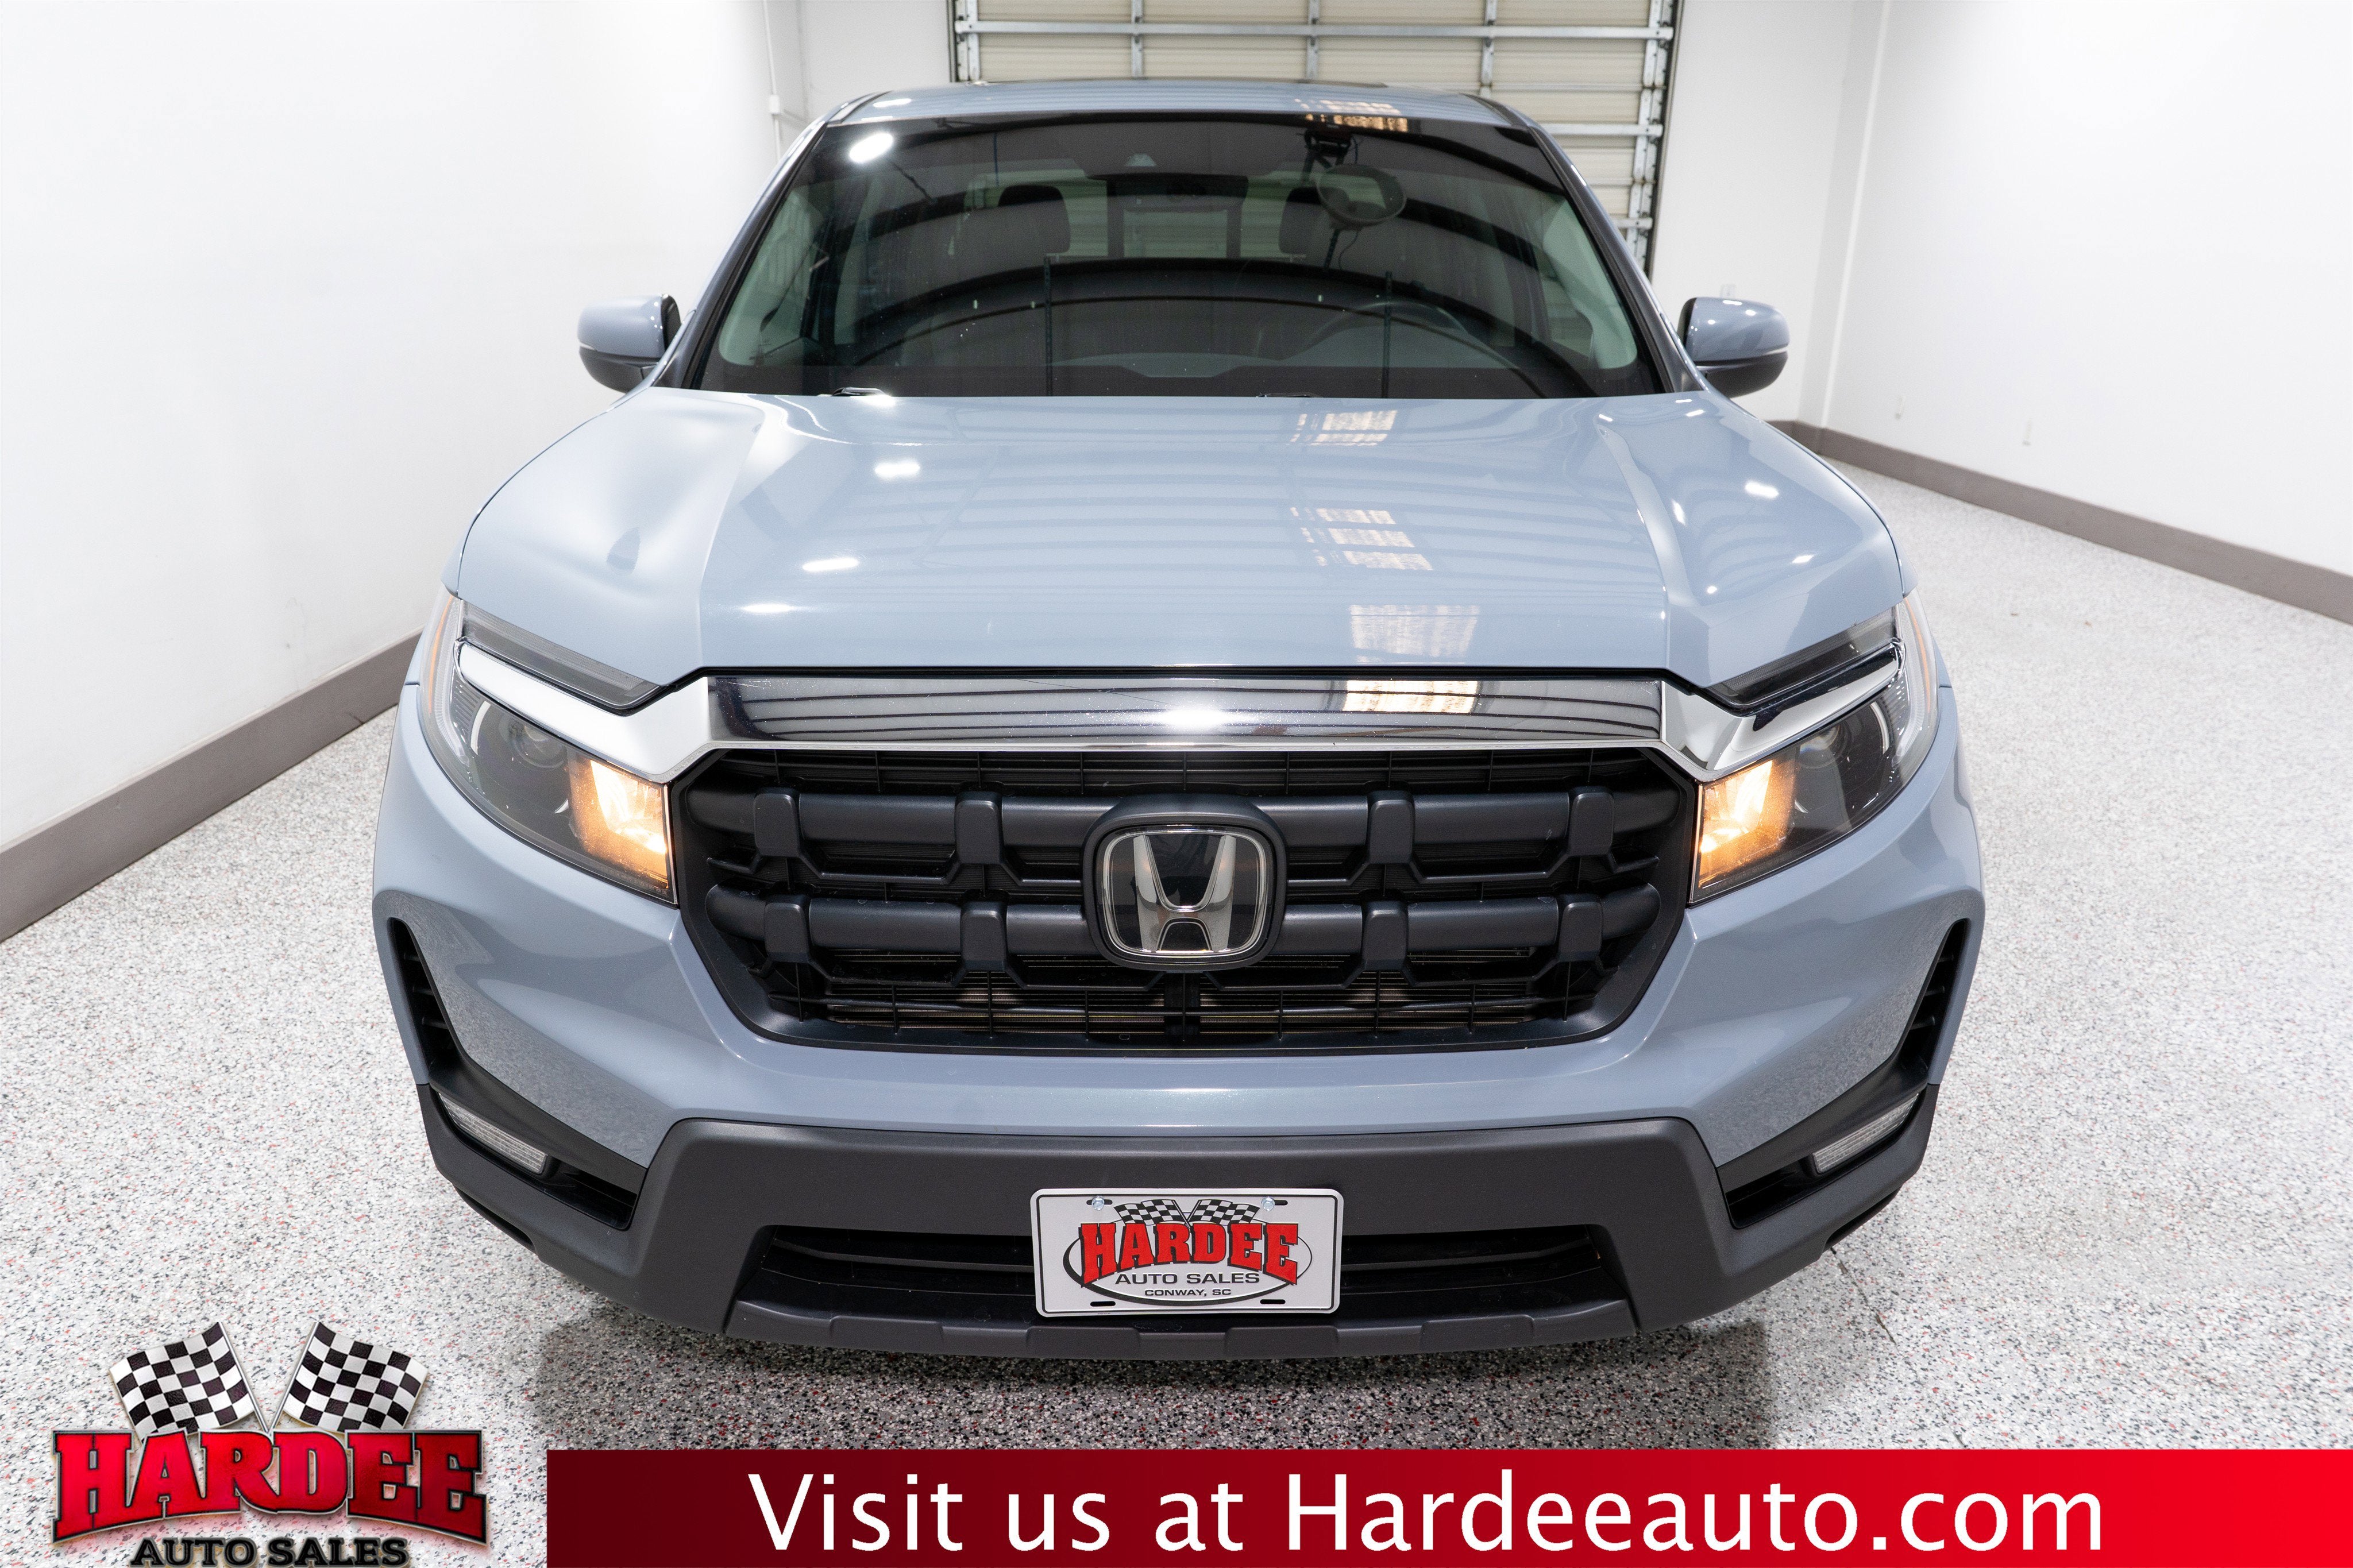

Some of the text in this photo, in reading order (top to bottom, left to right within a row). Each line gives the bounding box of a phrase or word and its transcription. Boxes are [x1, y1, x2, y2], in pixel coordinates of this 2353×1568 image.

[1079, 1223, 1299, 1287] HARDEE
[1115, 1273, 1260, 1284] AUTO SALES
